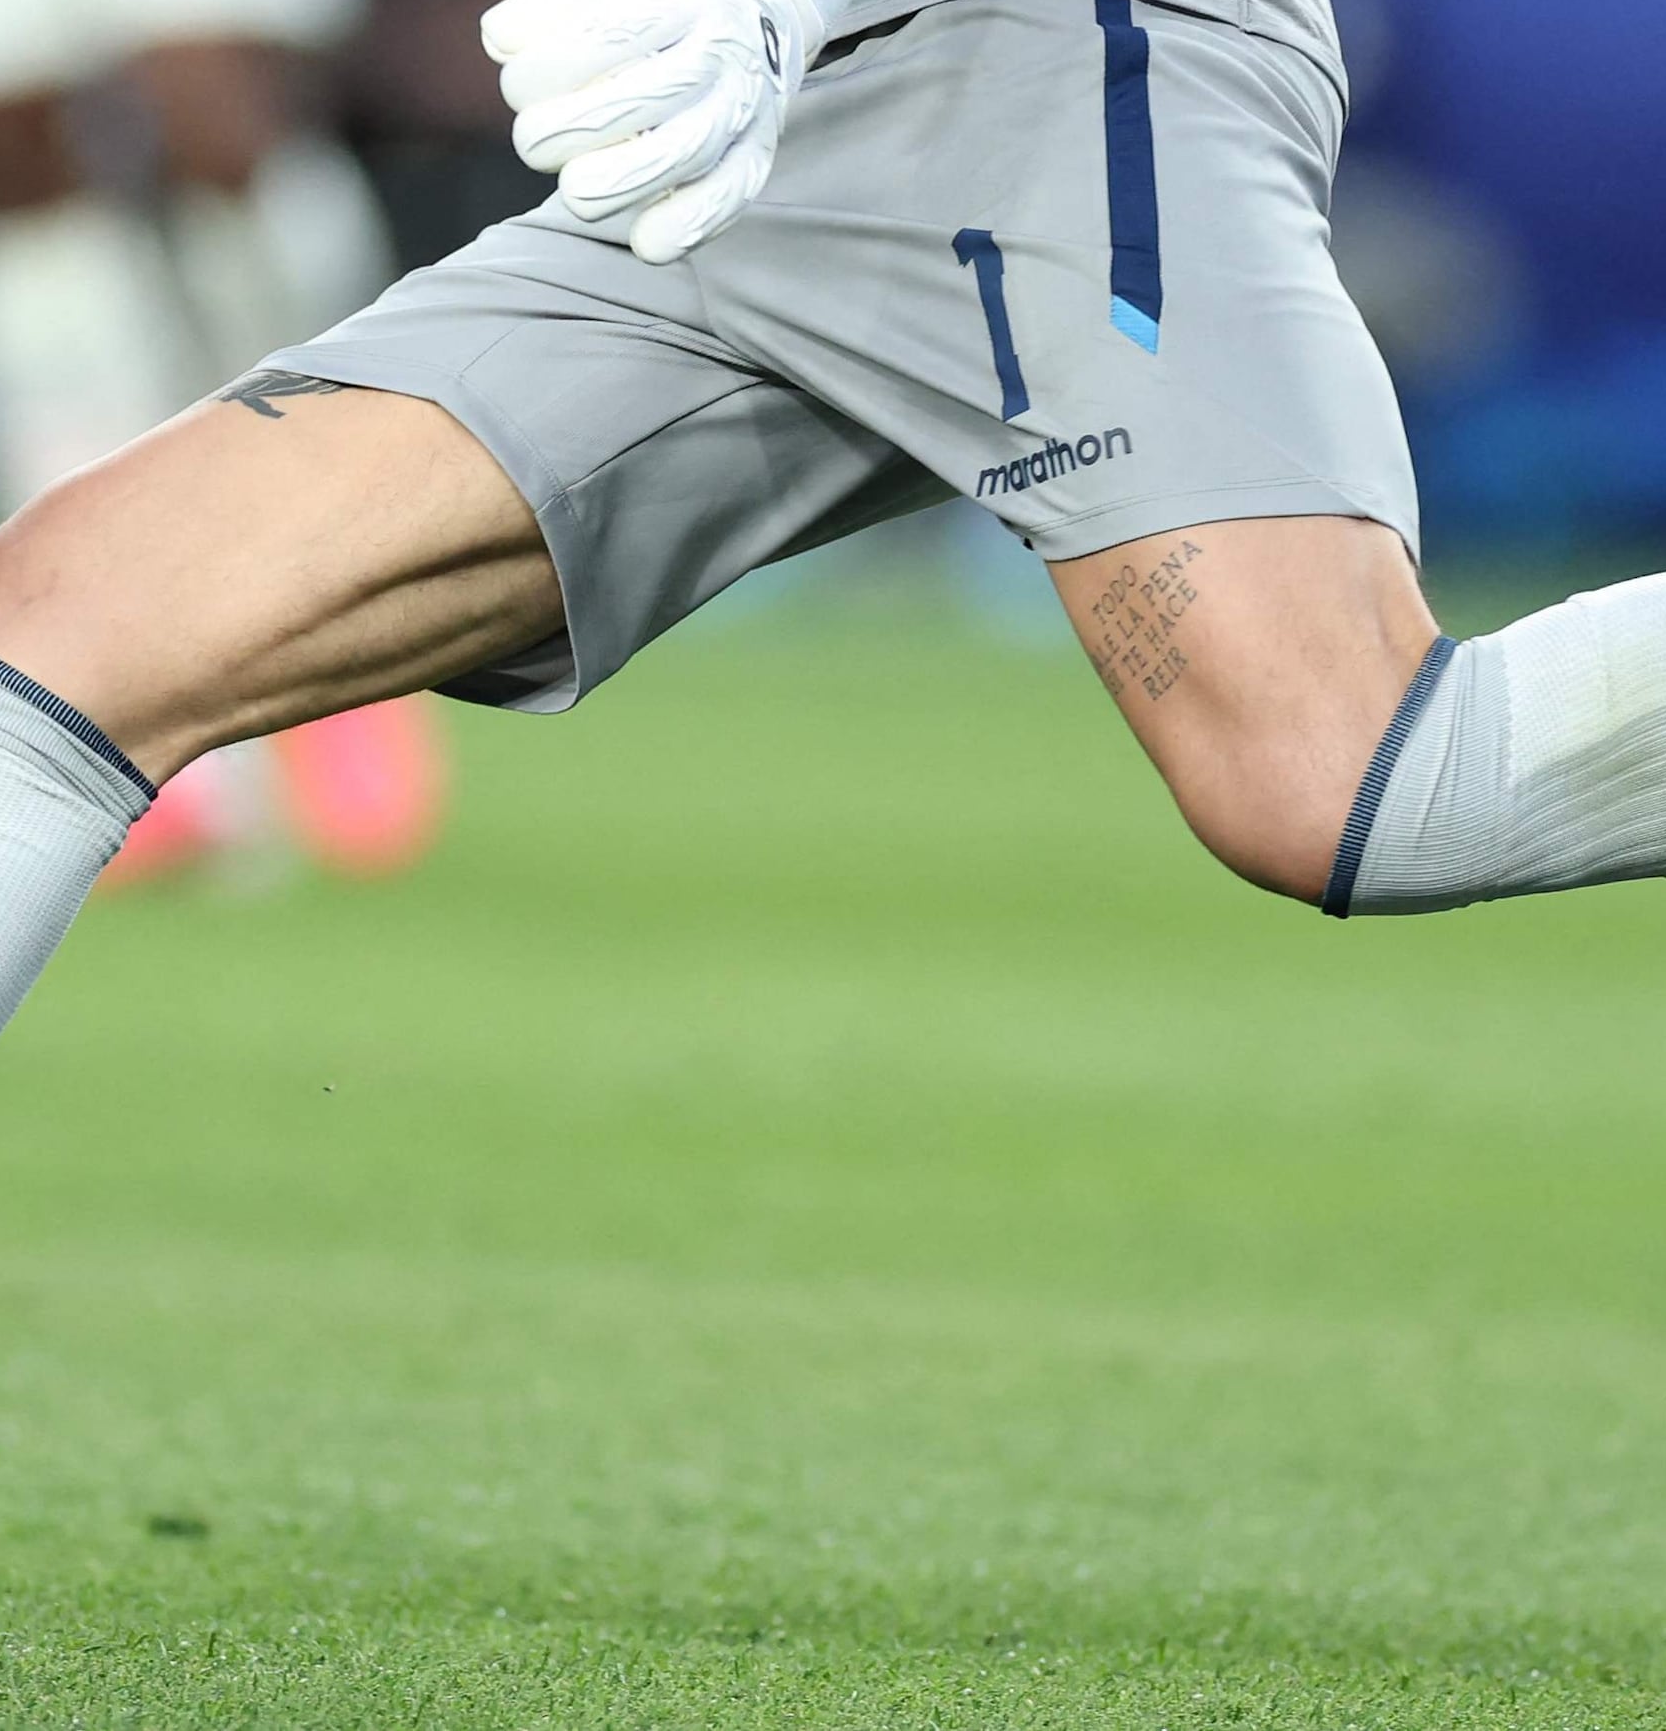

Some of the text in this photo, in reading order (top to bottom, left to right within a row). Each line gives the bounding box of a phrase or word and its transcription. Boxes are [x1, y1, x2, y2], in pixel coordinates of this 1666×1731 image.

[951, 227, 1030, 423] 1
[975, 426, 1133, 498] marathon
[1092, 565, 1138, 625] TODO
[1116, 606, 1145, 640] LA
[1140, 539, 1203, 608] PENA
[1122, 645, 1148, 678] TE
[1144, 579, 1198, 653] HACE
[1142, 646, 1188, 701] REIR
